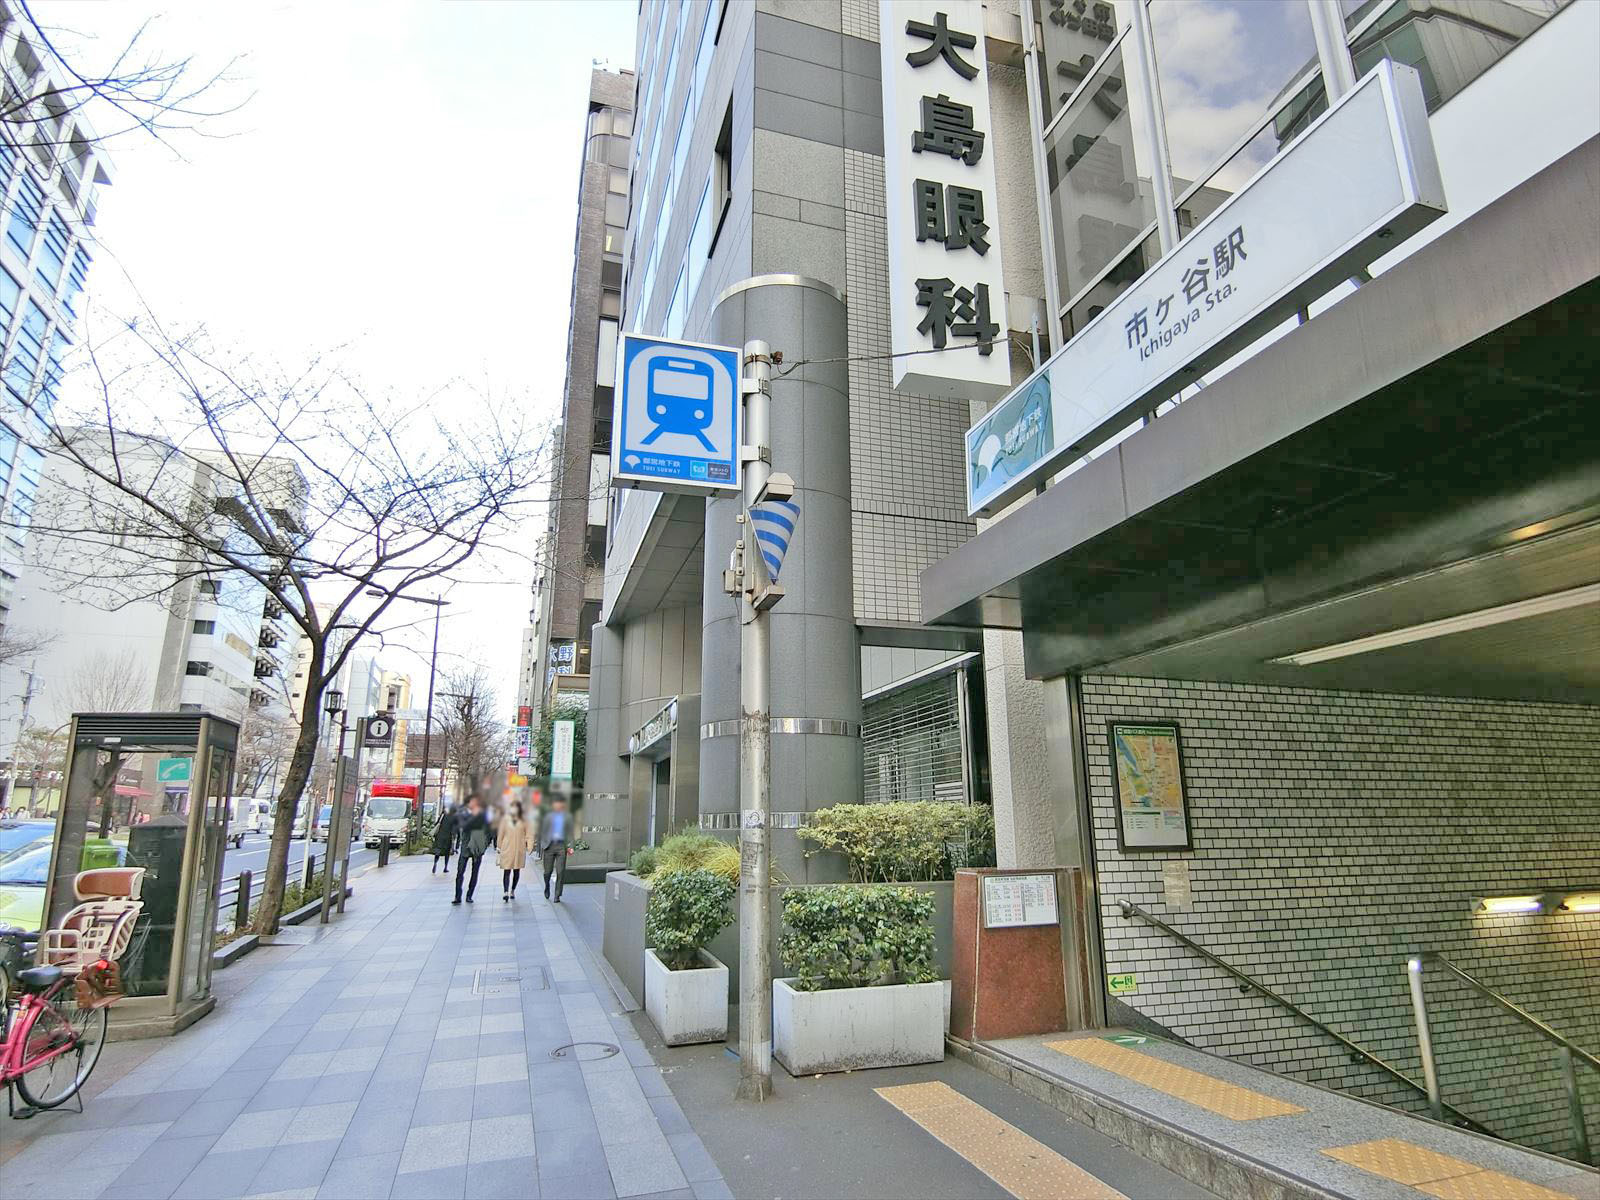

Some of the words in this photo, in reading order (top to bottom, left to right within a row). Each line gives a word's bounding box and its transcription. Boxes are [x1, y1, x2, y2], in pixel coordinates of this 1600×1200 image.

[905, 11, 1000, 356] 大島眼科
[1140, 307, 1200, 361] Ichigaya
[1205, 283, 1237, 311] Sta.
[643, 457, 680, 468] 都営地下鉄
[657, 466, 680, 474] SUBWAY
